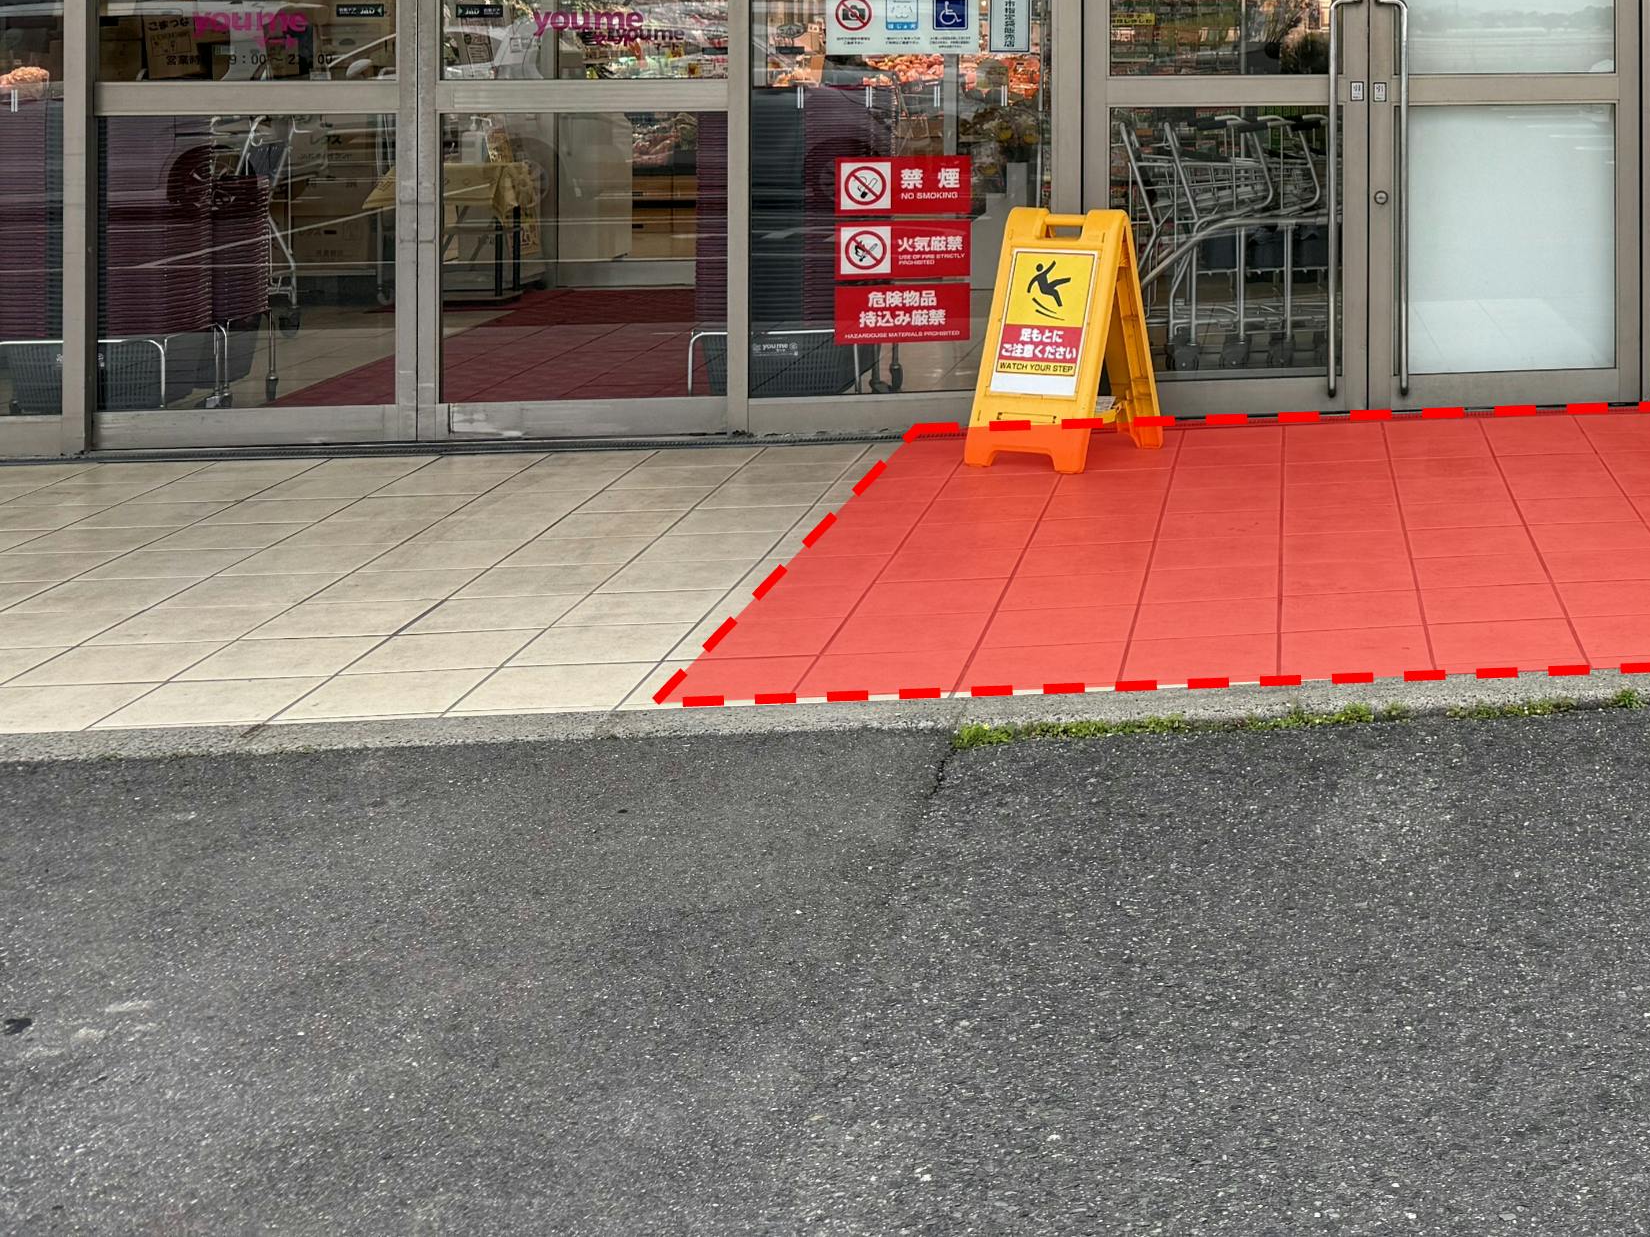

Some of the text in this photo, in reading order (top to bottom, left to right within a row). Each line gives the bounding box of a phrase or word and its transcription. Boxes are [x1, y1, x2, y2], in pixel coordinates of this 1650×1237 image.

[901, 191, 958, 200] NO SMOKING
[897, 236, 963, 252] 火気厳禁
[868, 290, 937, 308] 危険物品
[858, 309, 946, 328] 持込み厳禁
[924, 329, 960, 337] PROHIBITED
[1019, 327, 1064, 343] 足もとに
[1001, 343, 1077, 360] ご注意ください
[1000, 361, 1074, 373] WATCH YOUR STEP
